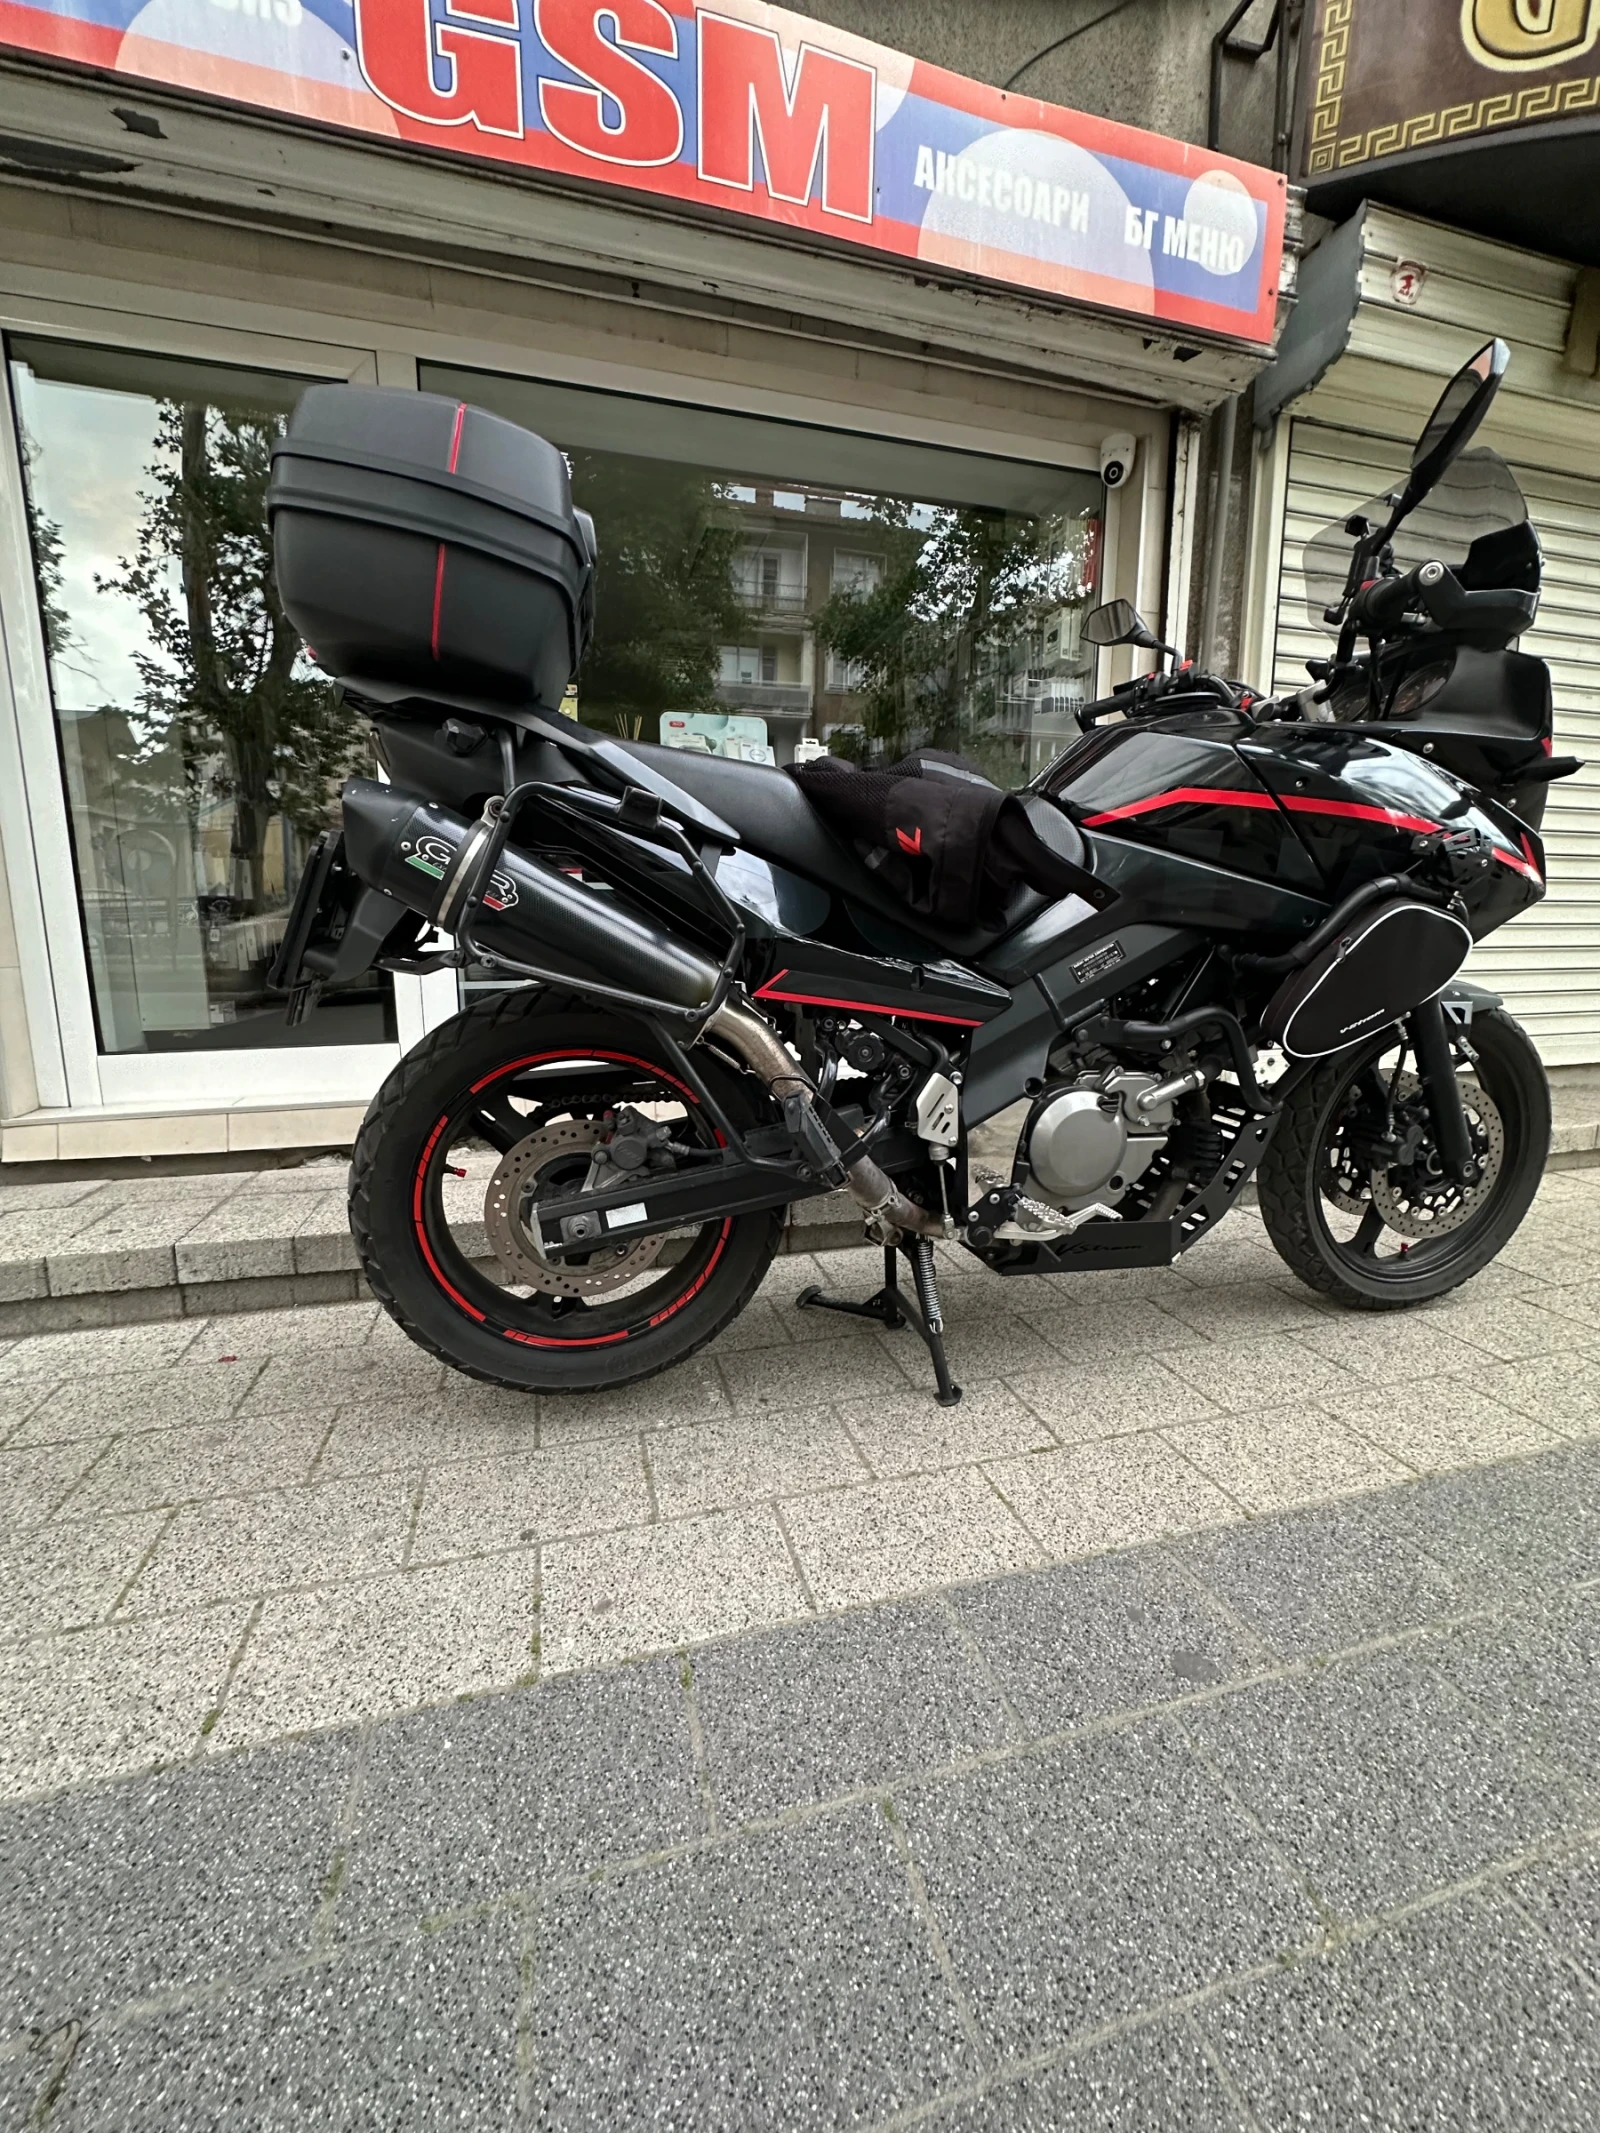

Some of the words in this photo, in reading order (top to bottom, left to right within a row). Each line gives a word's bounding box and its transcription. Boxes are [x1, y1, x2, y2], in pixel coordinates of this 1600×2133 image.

[354, 0, 878, 224] GSM
[914, 145, 1091, 234] АКСЕСОАРИ
[1124, 204, 1159, 250] БГ
[1162, 216, 1245, 273] МЕНЮ
